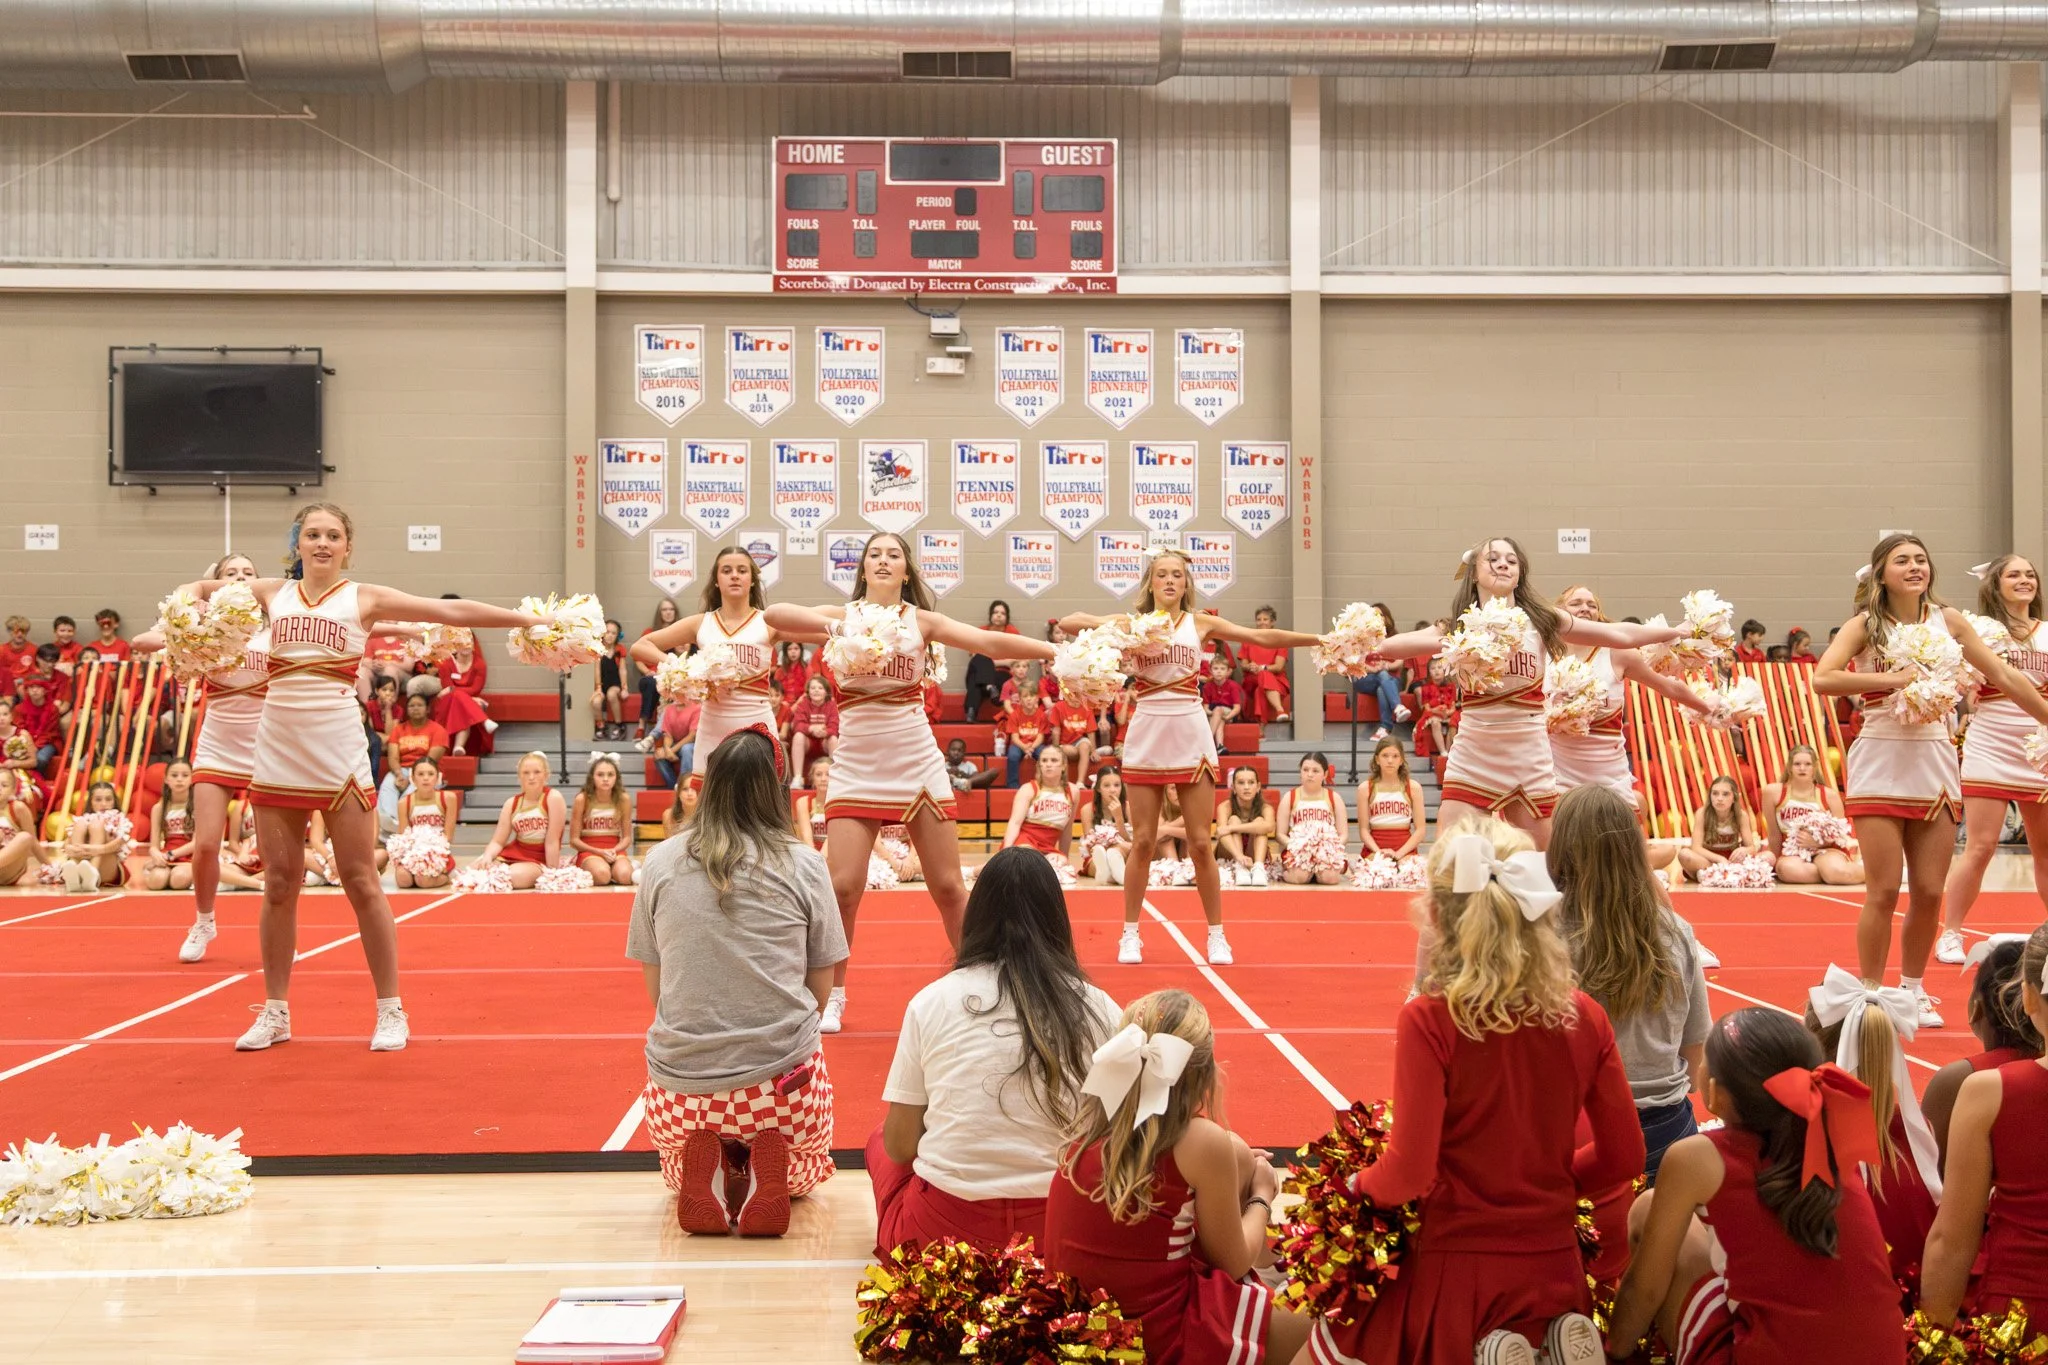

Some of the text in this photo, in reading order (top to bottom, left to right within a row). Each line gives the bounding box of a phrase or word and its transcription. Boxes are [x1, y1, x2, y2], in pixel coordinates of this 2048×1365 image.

[788, 143, 845, 164] HOME
[1041, 145, 1105, 165] GUEST
[916, 197, 952, 208] PERIOD
[787, 219, 819, 230] FOULS
[852, 219, 878, 230] T.O.L.
[909, 219, 981, 231] PLAYER FOUL
[1013, 220, 1038, 231] T.O.L.
[1071, 220, 1103, 231] FOULS
[787, 258, 819, 269] SCORE
[928, 259, 962, 270] MATCH
[1071, 259, 1103, 271] SCORE
[779, 277, 850, 290] Scoreboard
[853, 277, 907, 290] Donated
[909, 278, 926, 293] by
[928, 278, 972, 291] Electra
[974, 279, 1055, 291] Construction
[1086, 280, 1110, 291] Inc.
[733, 368, 789, 380] VOLLEYBALL
[821, 368, 878, 380] VOLLEYBALL
[1001, 369, 1058, 381] VOLLEYBALL
[1091, 370, 1148, 382] BASKETBALL
[1202, 371, 1238, 381] ATHLETICS
[641, 379, 699, 391] CHAMPIONS
[732, 380, 790, 393] CHAMPION
[821, 380, 878, 392] CHAMPION
[1001, 381, 1058, 393] CHAMPION
[1090, 381, 1148, 394] RUNNERUP
[1180, 381, 1238, 392] CHAMPION
[656, 396, 685, 408] 2018
[756, 393, 768, 402] 1A
[835, 395, 865, 406] 2020
[1015, 396, 1044, 406] 2021
[1104, 397, 1133, 408] 2021
[1195, 397, 1223, 407] 2021
[749, 403, 774, 413] 2018
[1024, 409, 1036, 417] 1A
[1114, 410, 1126, 418] 1A
[1204, 410, 1215, 418] 1A
[604, 481, 661, 492] VOLLEYBALL
[687, 481, 743, 493] BASKETBALL
[776, 481, 833, 493] BASKETBALL
[957, 481, 1014, 493] TENNIS
[1046, 482, 1103, 494] VOLLEYBALL
[1135, 483, 1192, 495] VOLLEYBALL
[1239, 482, 1273, 495] GOLF
[573, 455, 588, 549] WARRIORS
[603, 491, 662, 504] CHAMPION
[686, 492, 745, 505] CHAMPIONS
[775, 492, 834, 505] CHAMPIONS
[957, 492, 1014, 505] CHAMPION
[1045, 493, 1103, 505] CHAMPION
[1135, 494, 1192, 506] CHAMPION
[1227, 494, 1285, 507] CHAMPION
[1300, 457, 1313, 549] WARRIORS
[618, 507, 648, 518] 2022
[790, 507, 820, 518] 2022
[865, 501, 922, 513] CHAMPION
[971, 507, 1001, 518] 2023
[700, 508, 730, 519] 2022
[1060, 508, 1089, 519] 2023
[1149, 509, 1178, 520] 2024
[1241, 510, 1270, 521] 2025
[627, 520, 639, 529] 1A
[709, 520, 721, 529] 1A
[800, 520, 812, 528] 1A
[980, 520, 992, 529] 1A
[1070, 521, 1081, 529] 1A
[1158, 522, 1170, 530] 1A
[1251, 522, 1262, 531] 1A
[1012, 556, 1052, 564] REGIONAL
[1191, 556, 1230, 564] DISTRICT
[923, 563, 959, 571] TENNIS
[1100, 563, 1140, 571] TENNIS
[1190, 564, 1230, 572] TENNIS
[653, 568, 692, 578] CHAMPION
[922, 571, 959, 579] CHAMPION
[1099, 571, 1140, 580] CHAMPION
[272, 616, 347, 653] WARRIORS
[1370, 800, 1410, 817] WARRIORS
[1780, 807, 1813, 820] WARRI
[1292, 808, 1332, 825] WARRIORS
